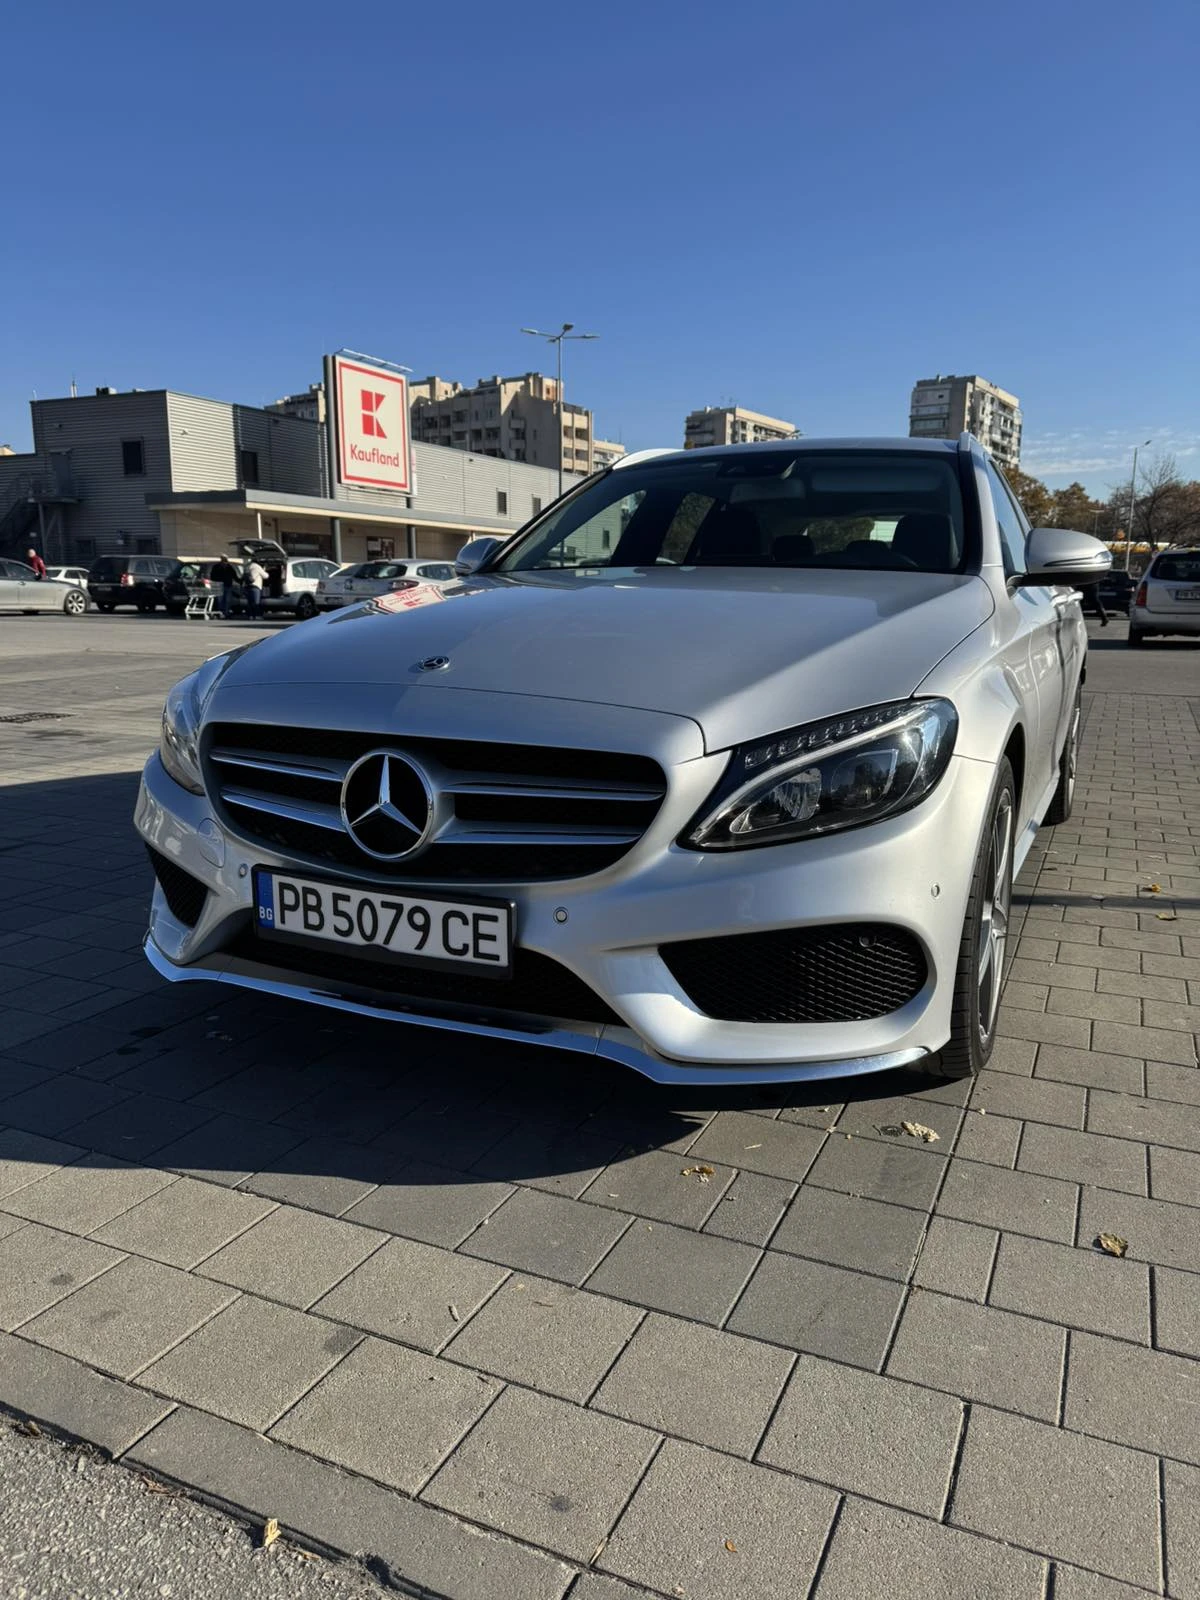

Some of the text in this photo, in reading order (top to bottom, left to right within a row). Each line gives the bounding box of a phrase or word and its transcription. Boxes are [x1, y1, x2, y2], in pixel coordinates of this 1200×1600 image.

[361, 389, 387, 439] K
[350, 443, 400, 467] Kaufland
[258, 905, 273, 921] BG
